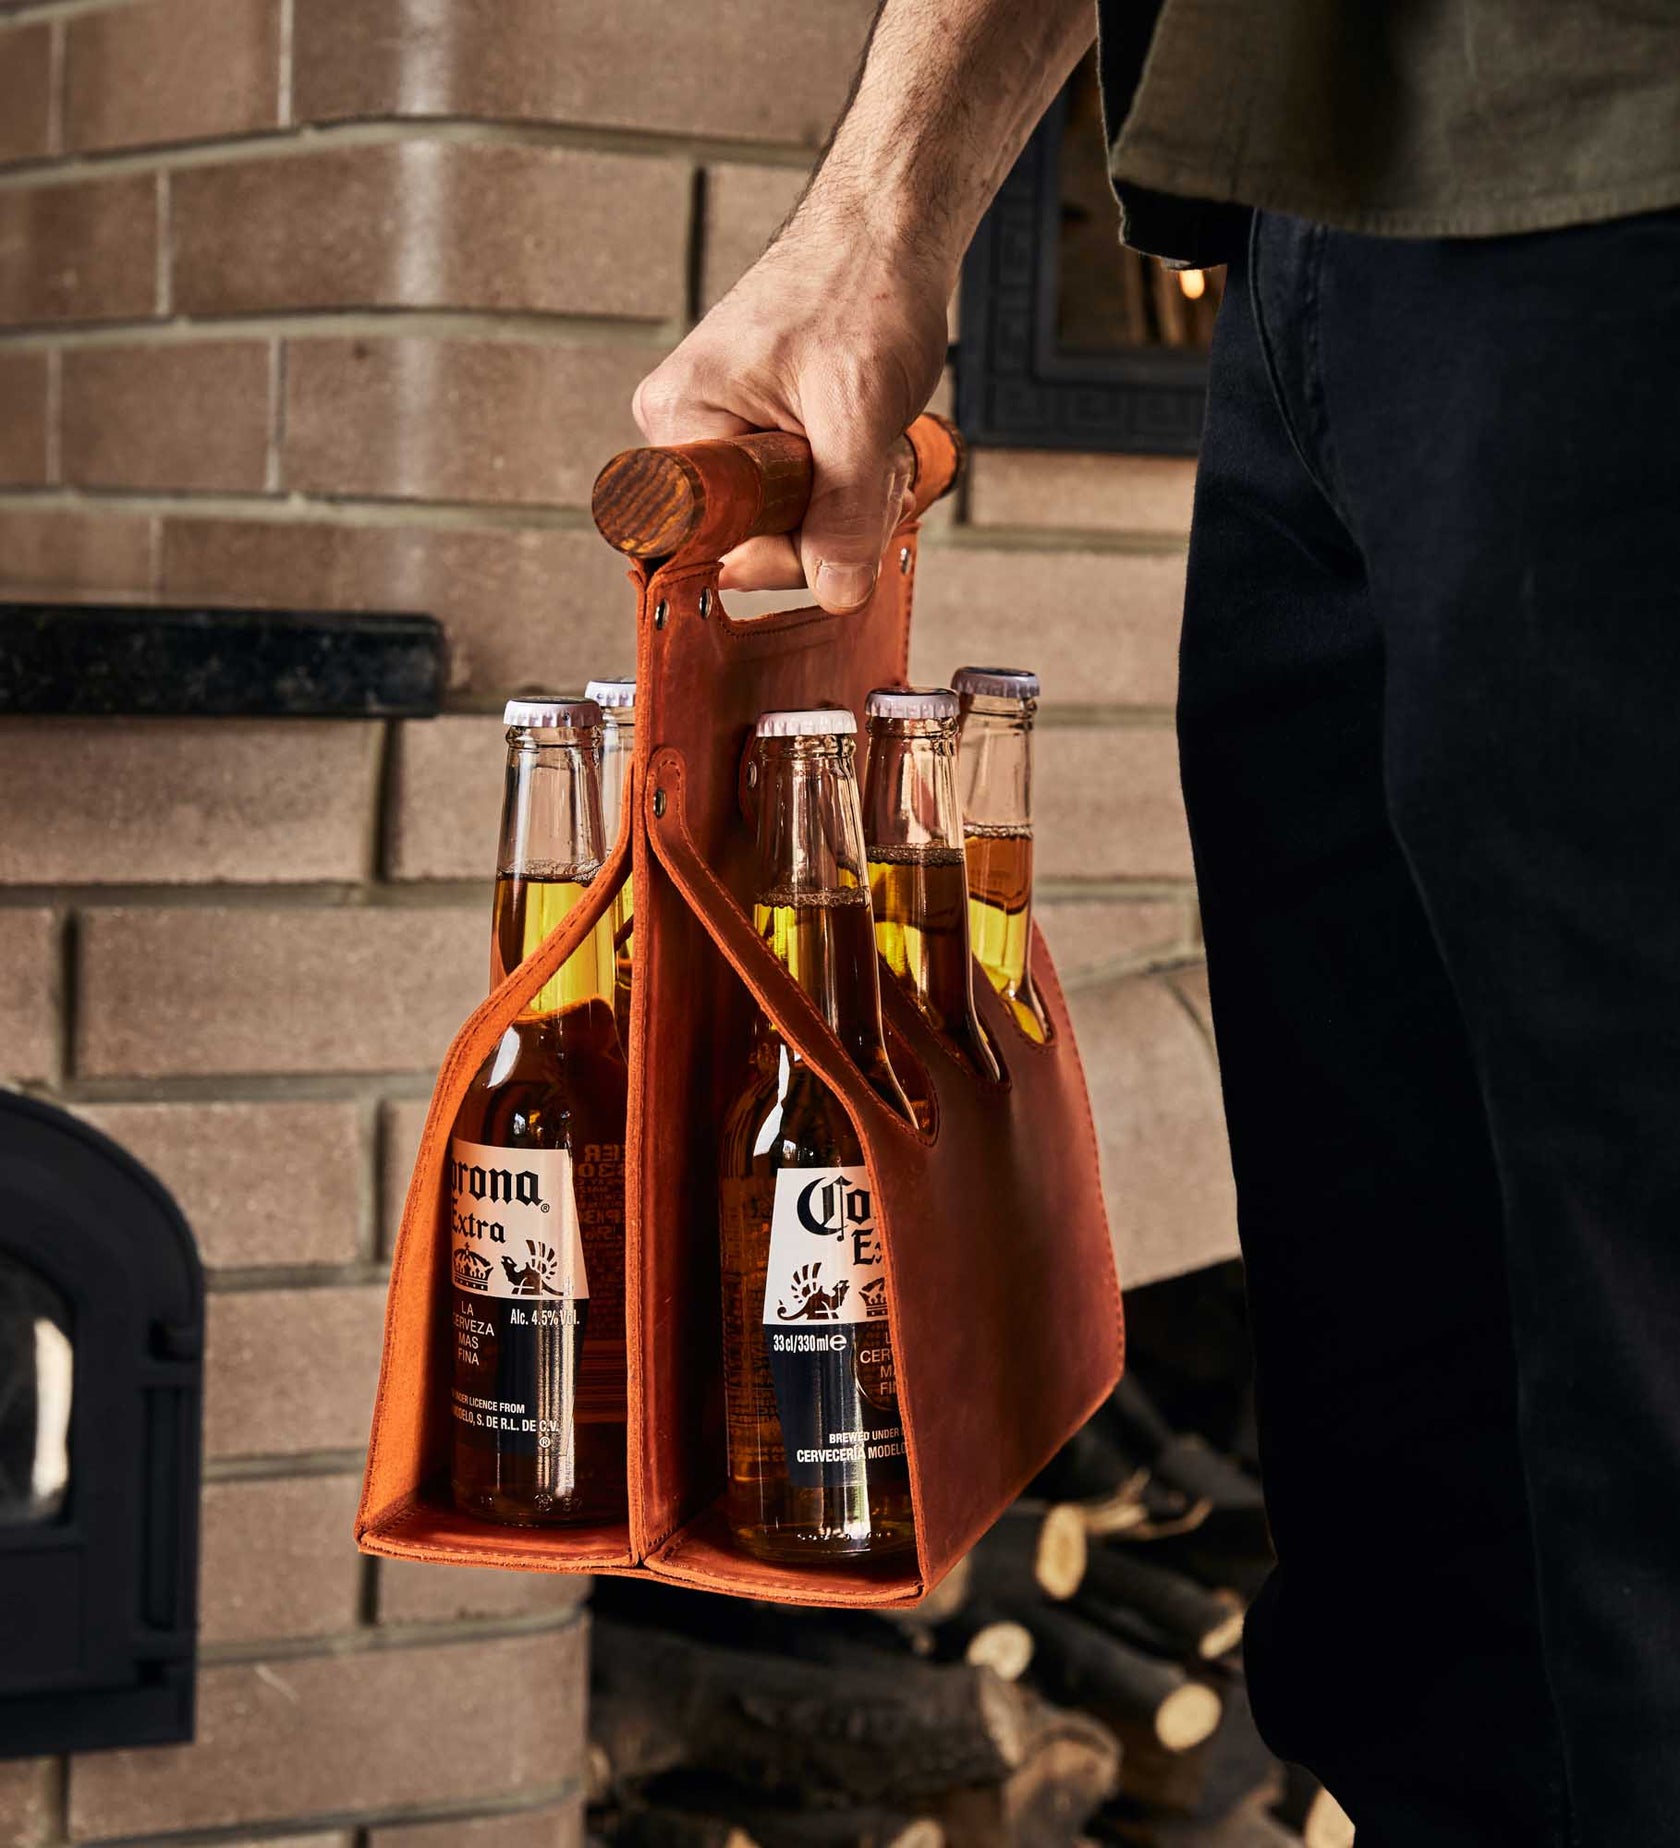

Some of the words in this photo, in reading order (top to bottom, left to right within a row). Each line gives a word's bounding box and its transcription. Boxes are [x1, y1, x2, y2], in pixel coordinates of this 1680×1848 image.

[797, 1175, 876, 1242] Co
[461, 1301, 474, 1316] LA
[510, 1308, 529, 1326] Alc.
[532, 1309, 559, 1326] 4.5%
[560, 1309, 581, 1326] Vol.
[459, 1332, 479, 1349] MAS
[458, 1347, 480, 1366] FINA
[860, 1348, 891, 1364] CER
[469, 1397, 498, 1411] LICENCE
[499, 1402, 525, 1414] FROM
[486, 1415, 499, 1429] DE
[500, 1417, 520, 1431] R.L.
[522, 1419, 537, 1432] DE
[539, 1420, 559, 1432] C.V.
[829, 1430, 870, 1444] BREWED
[871, 1427, 900, 1440] UNDER
